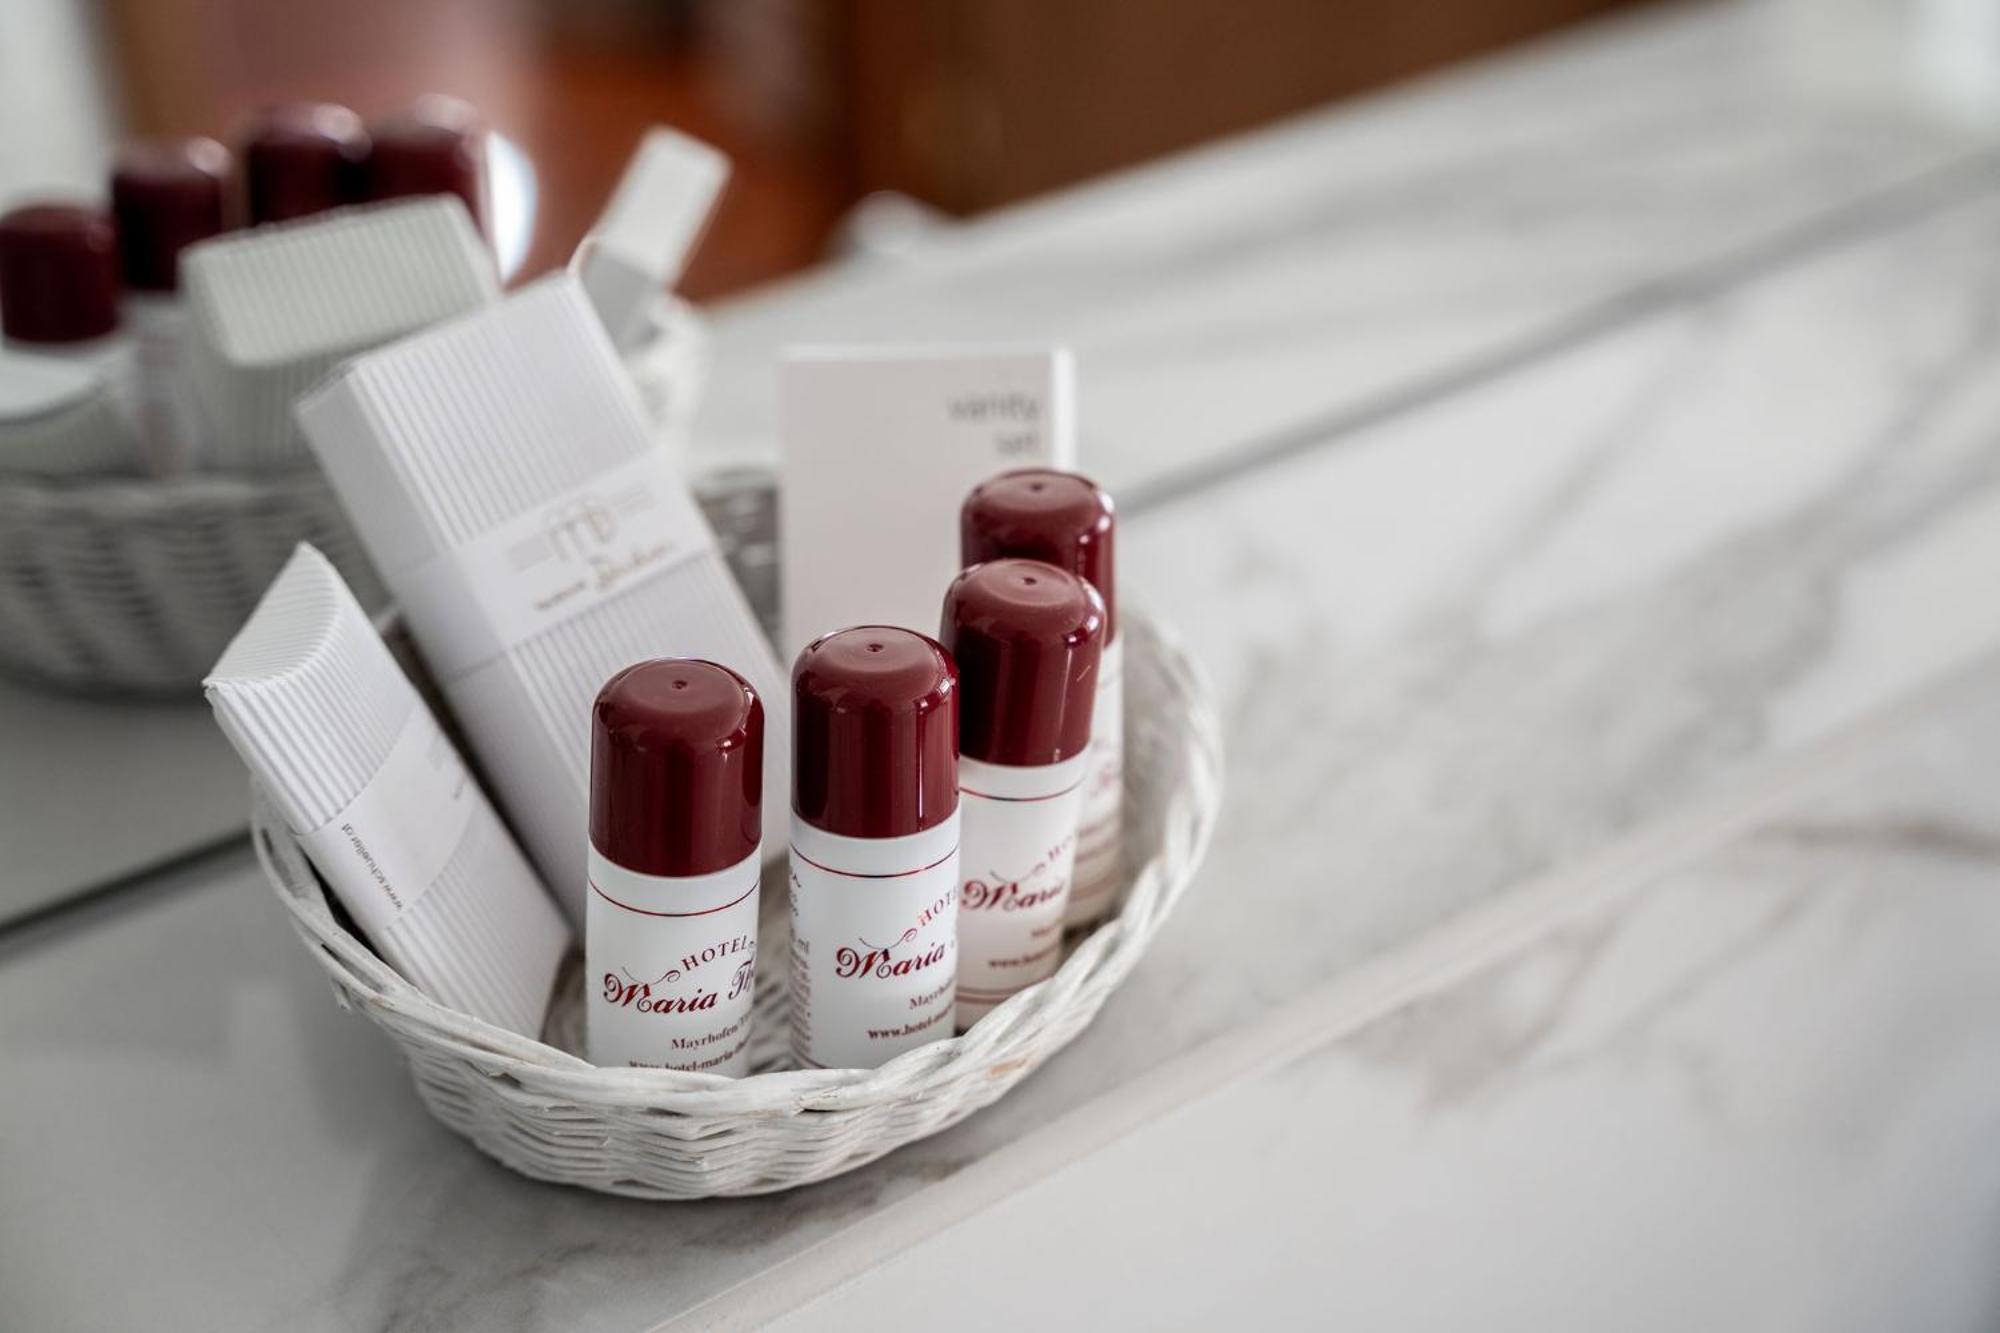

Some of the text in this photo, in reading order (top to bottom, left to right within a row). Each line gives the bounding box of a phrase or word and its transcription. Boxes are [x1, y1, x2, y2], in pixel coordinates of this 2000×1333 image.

[681, 934, 748, 972] HOTEL
[836, 941, 946, 979] Maria
[603, 972, 719, 1015] Maria
[671, 1023, 739, 1051] Mayrhofen
